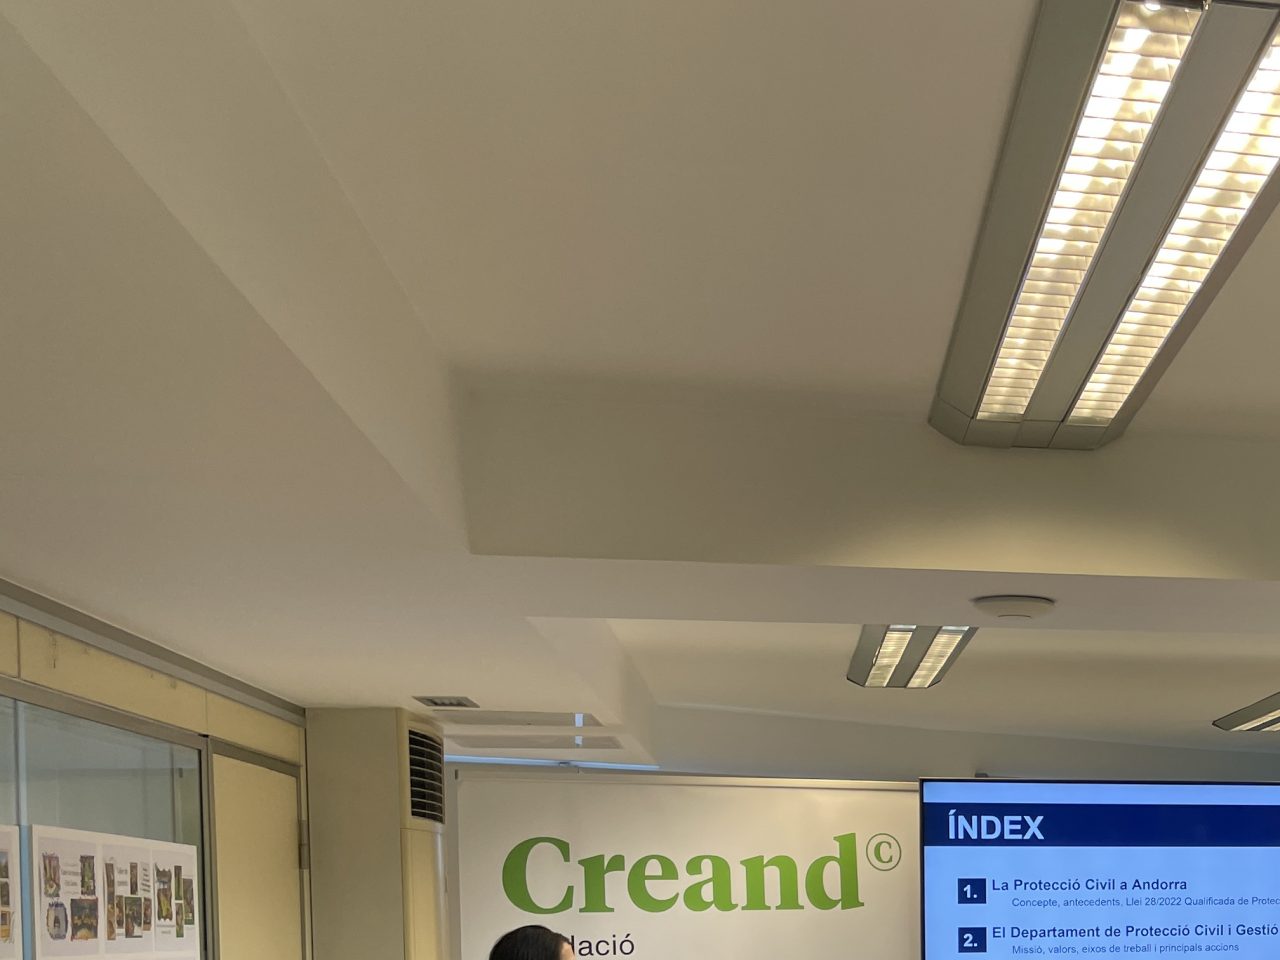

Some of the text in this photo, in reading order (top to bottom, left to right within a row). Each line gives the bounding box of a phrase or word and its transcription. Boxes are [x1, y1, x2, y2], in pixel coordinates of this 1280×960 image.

[948, 809, 1045, 840] ÍNDEX
[963, 878, 1187, 899] 1. La Protecció Civil a Andorra
[1012, 897, 1060, 909] Concepte,
[1145, 896, 1182, 906] 28/2022
[1185, 896, 1235, 906] Qualificada
[1238, 896, 1249, 905] de
[963, 934, 978, 947] 2.
[992, 927, 1006, 939] El
[1011, 926, 1100, 941] Departament
[1105, 926, 1121, 938] de
[1126, 925, 1190, 937] Protecció
[1194, 924, 1224, 936] Civil
[1228, 924, 1232, 936] i
[1236, 924, 1279, 936] Gestió
[1048, 945, 1079, 955] valors,
[1082, 945, 1107, 953] eixos
[1109, 944, 1120, 953] de
[1124, 944, 1151, 953] treball
[1159, 943, 1202, 955] principals
[1205, 943, 1239, 952] accions
